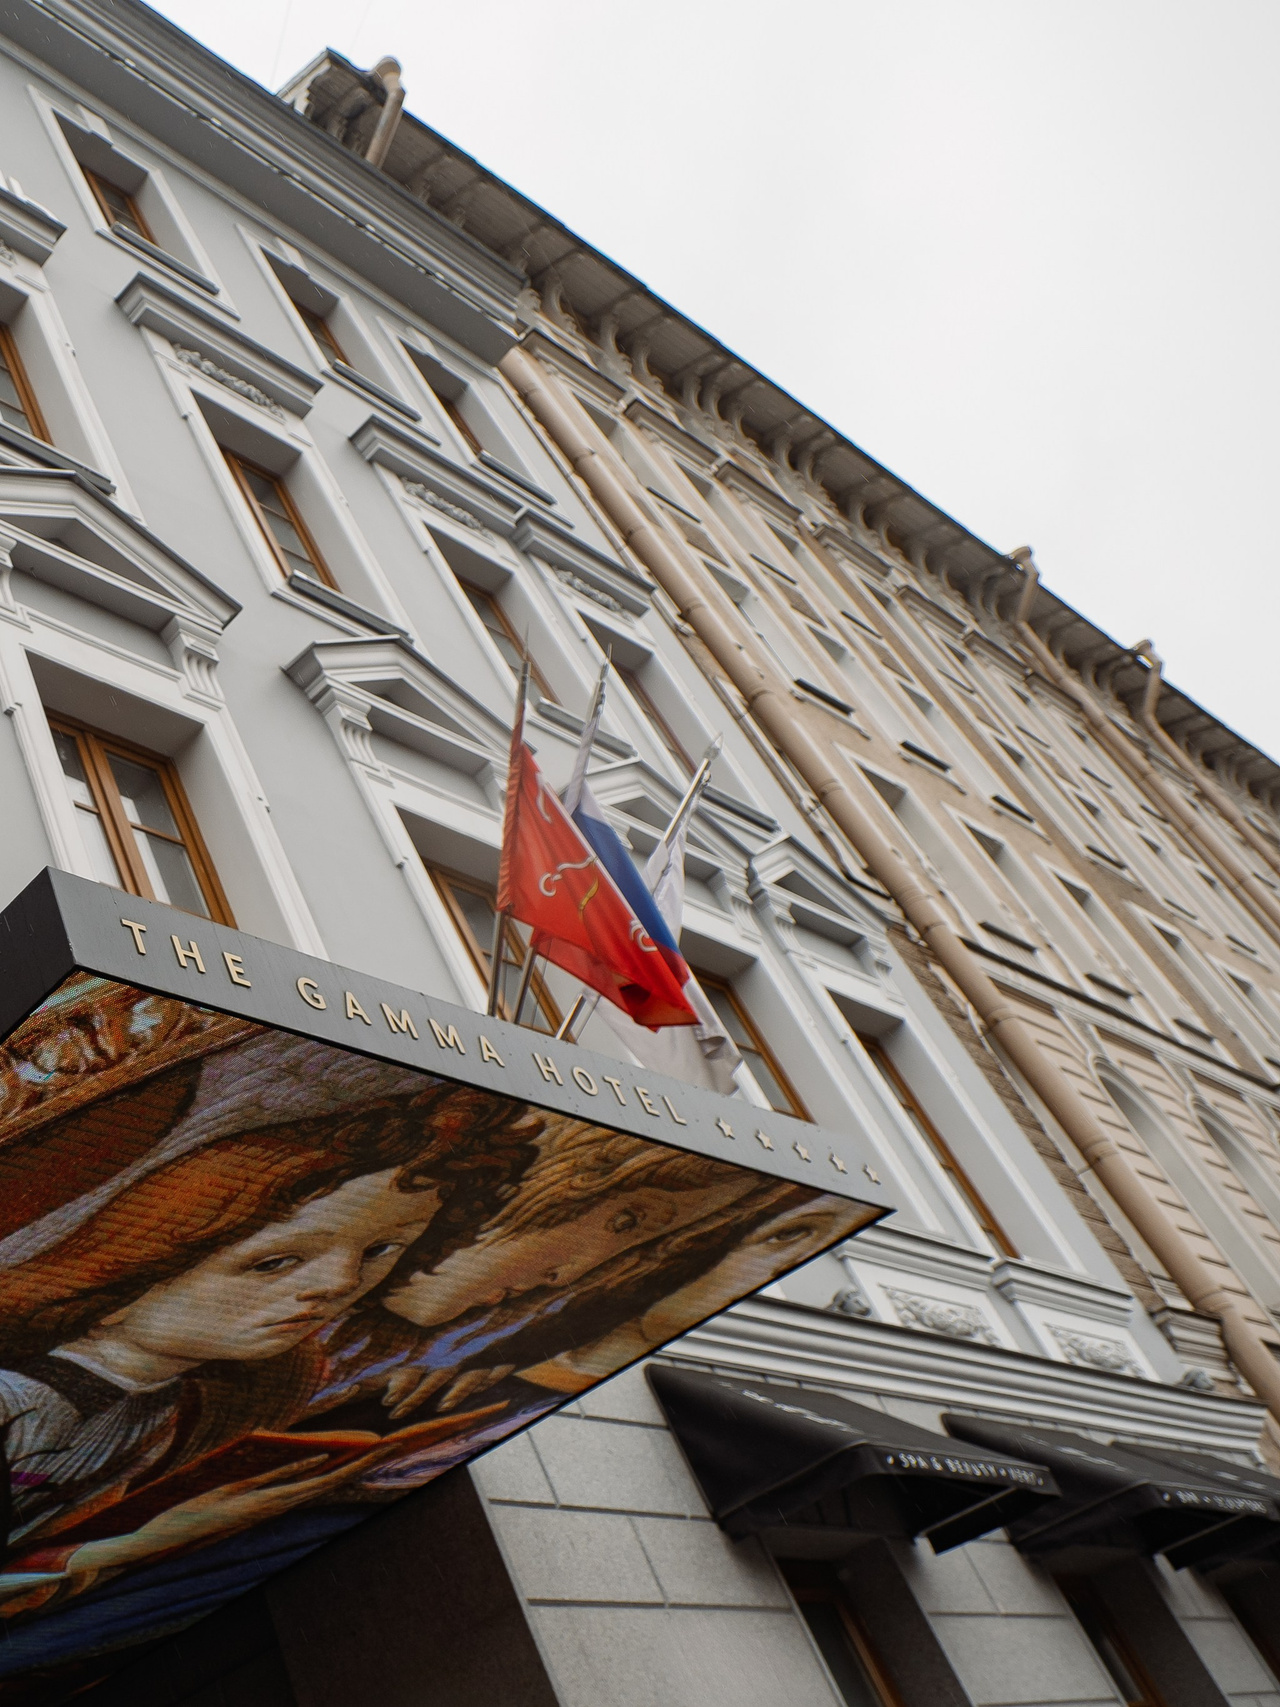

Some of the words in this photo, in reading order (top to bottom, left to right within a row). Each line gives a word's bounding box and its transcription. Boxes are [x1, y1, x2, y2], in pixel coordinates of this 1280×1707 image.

[121, 918, 252, 988] THE
[296, 976, 506, 1068] GAMMA
[532, 1052, 688, 1126] HOTEL
